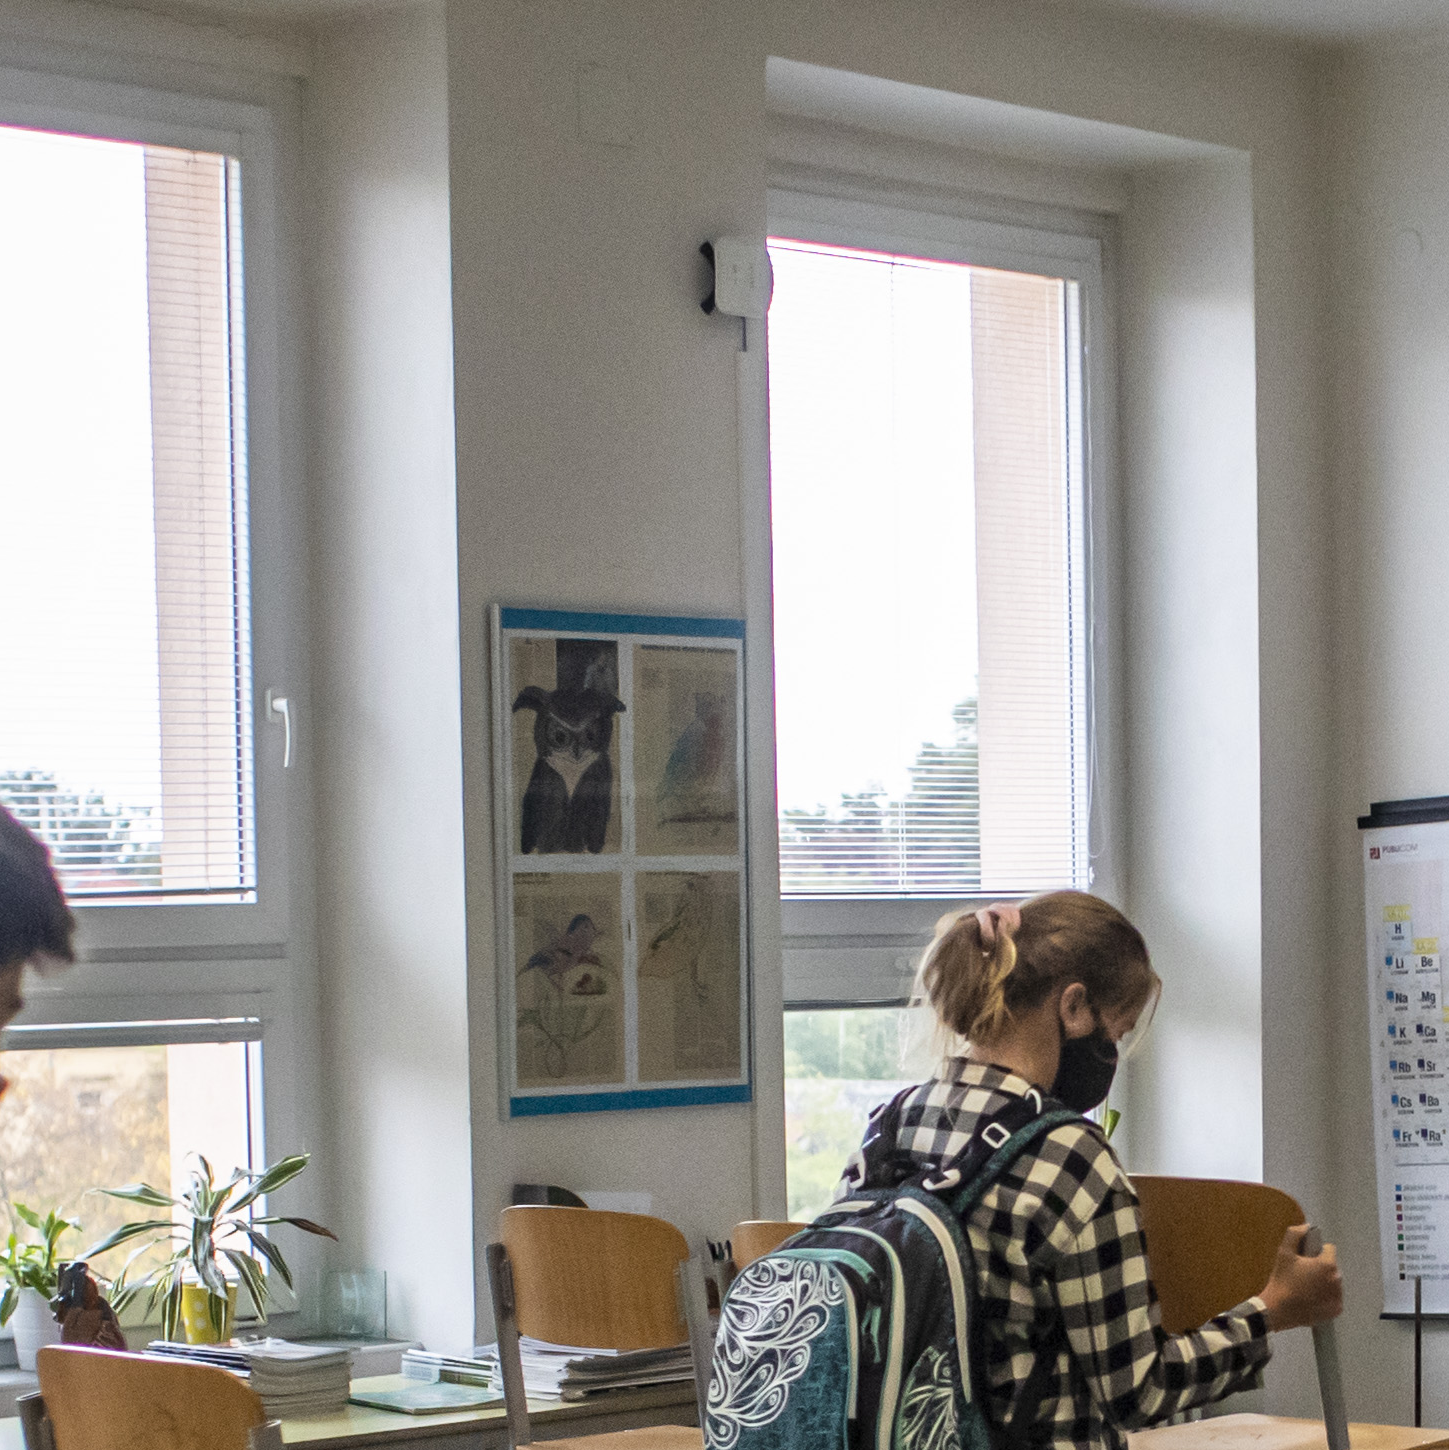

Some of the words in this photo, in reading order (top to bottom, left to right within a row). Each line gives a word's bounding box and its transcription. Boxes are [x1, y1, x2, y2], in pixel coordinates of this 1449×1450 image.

[1395, 923, 1402, 934] H
[1421, 956, 1433, 967] Be
[1395, 992, 1408, 1003] Na
[1421, 991, 1436, 1006] Mg
[1399, 1026, 1407, 1038] K
[1424, 1025, 1436, 1037] Ca
[1398, 1062, 1411, 1073] Rb
[1426, 1060, 1436, 1072] Sr
[1399, 1096, 1412, 1108] Cs
[1427, 1095, 1439, 1107] Ba
[1402, 1131, 1412, 1142] Fr
[1429, 1129, 1441, 1141] Ra
